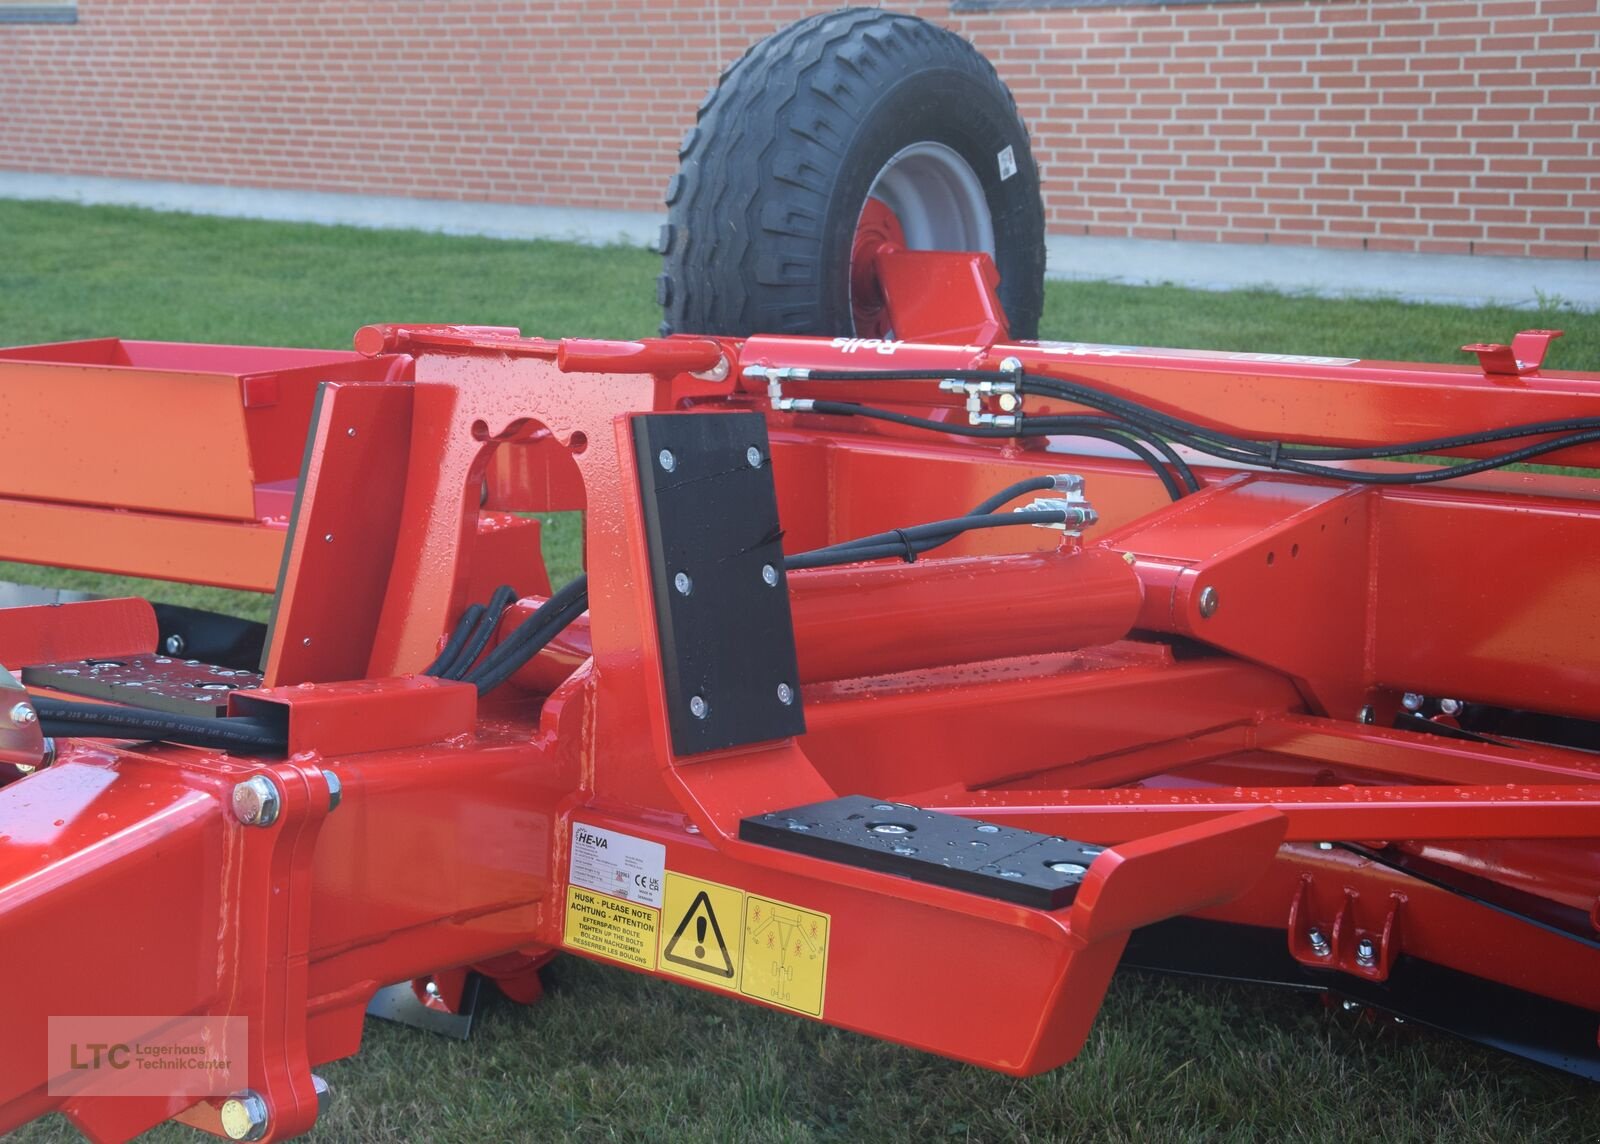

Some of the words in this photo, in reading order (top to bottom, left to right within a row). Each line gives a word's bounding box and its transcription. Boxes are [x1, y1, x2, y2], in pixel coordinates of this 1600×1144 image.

[578, 832, 608, 849] HE-VA
[570, 902, 607, 918] ACHTUNG
[612, 914, 654, 933] ATTENTION
[574, 892, 595, 905] HUSK
[601, 900, 630, 914] PLEASE
[631, 909, 652, 921] NOTE
[578, 922, 603, 935] TIGHTEN
[603, 929, 612, 937] UP
[612, 932, 625, 941] THE
[625, 936, 644, 947] BOLTS
[582, 916, 622, 933] EFTERSPÆND
[622, 927, 640, 939] BOLTE
[573, 936, 607, 951] RESSERRER
[607, 945, 618, 955] LES
[619, 949, 647, 964] BOULONS
[580, 931, 603, 943] BOLZEN
[603, 937, 640, 954] NACHZIEHEN
